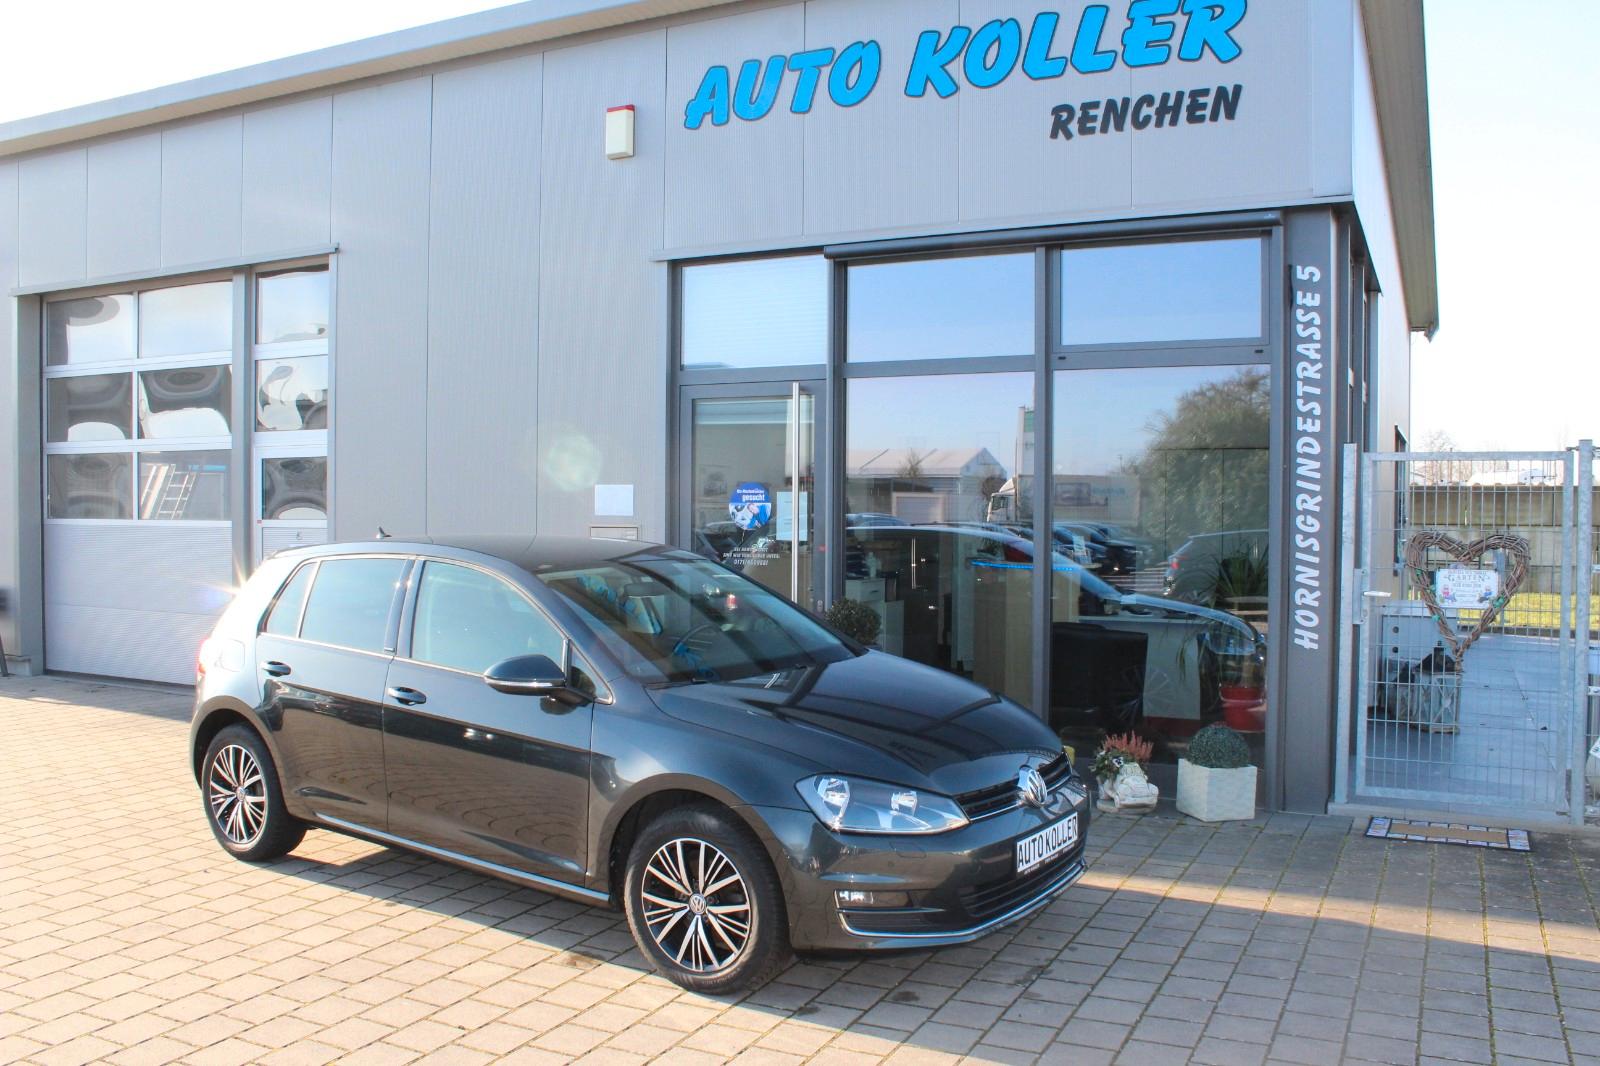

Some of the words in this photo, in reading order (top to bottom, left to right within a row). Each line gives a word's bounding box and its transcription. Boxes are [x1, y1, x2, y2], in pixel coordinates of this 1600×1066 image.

[684, 40, 881, 130] AUTO
[904, 0, 1247, 98] KOLLER
[1049, 84, 1243, 140] RENCHEN
[1296, 265, 1321, 283] 5
[1294, 290, 1323, 650] HORNISGRINDESTRASSE
